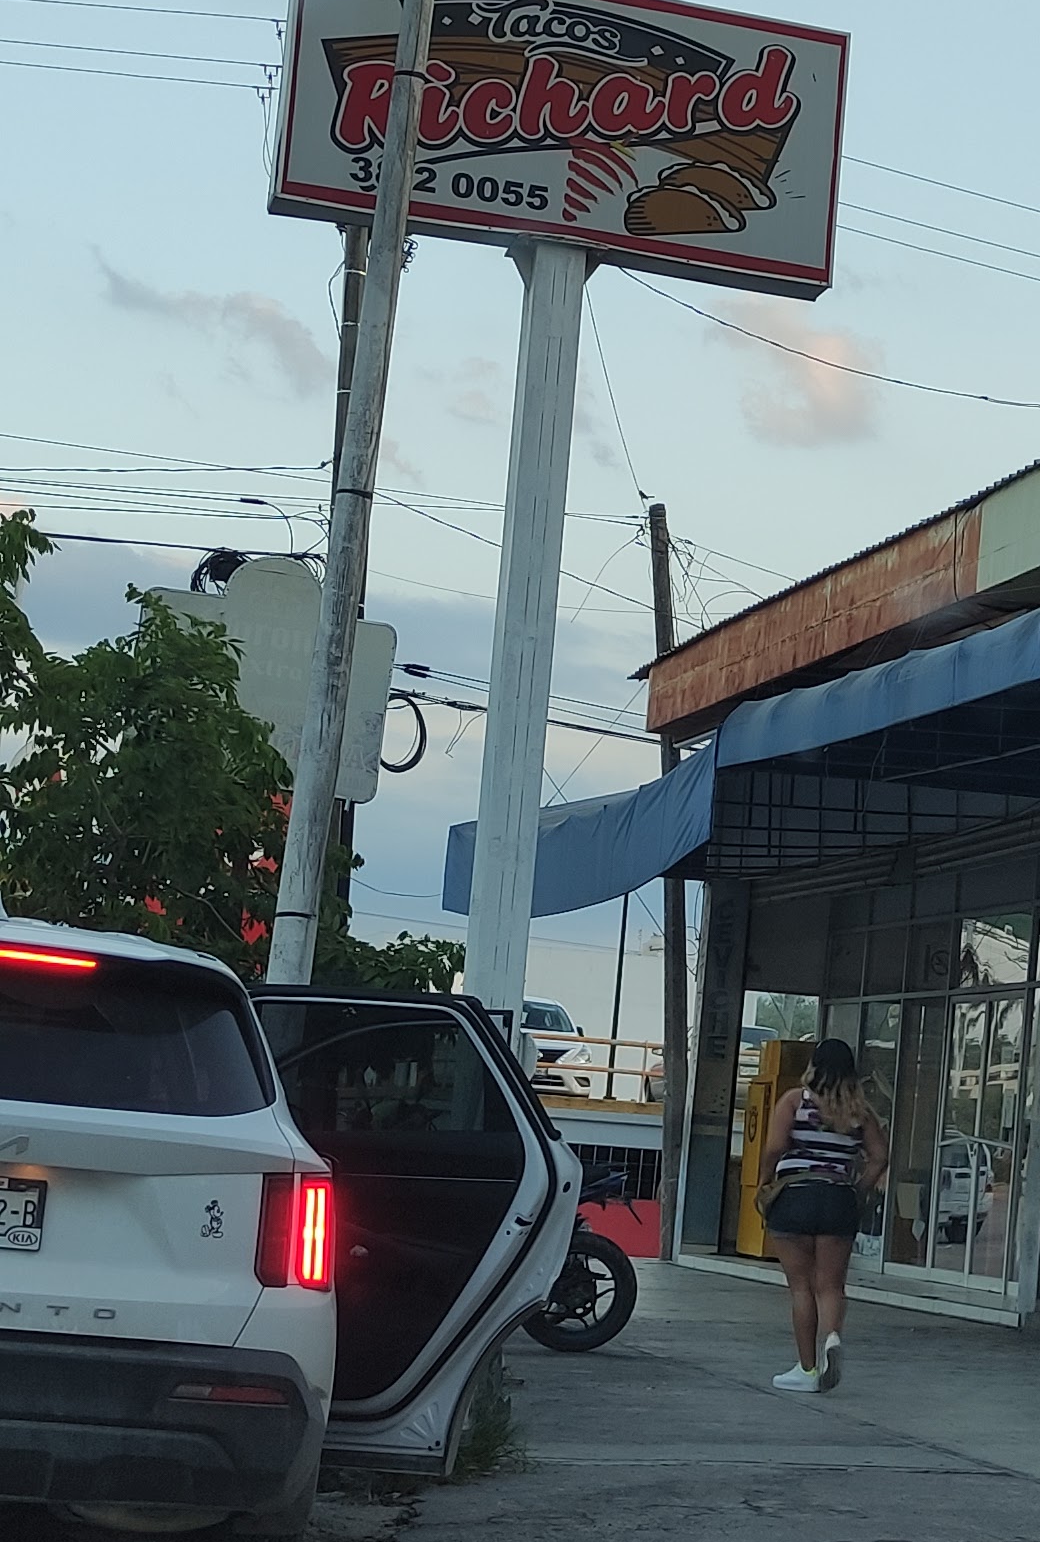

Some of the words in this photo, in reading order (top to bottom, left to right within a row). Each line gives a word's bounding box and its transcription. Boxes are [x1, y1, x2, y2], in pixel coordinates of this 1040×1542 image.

[332, 46, 798, 148] Richard
[451, 172, 549, 211] 0055
[11, 1232, 34, 1245] KIA
